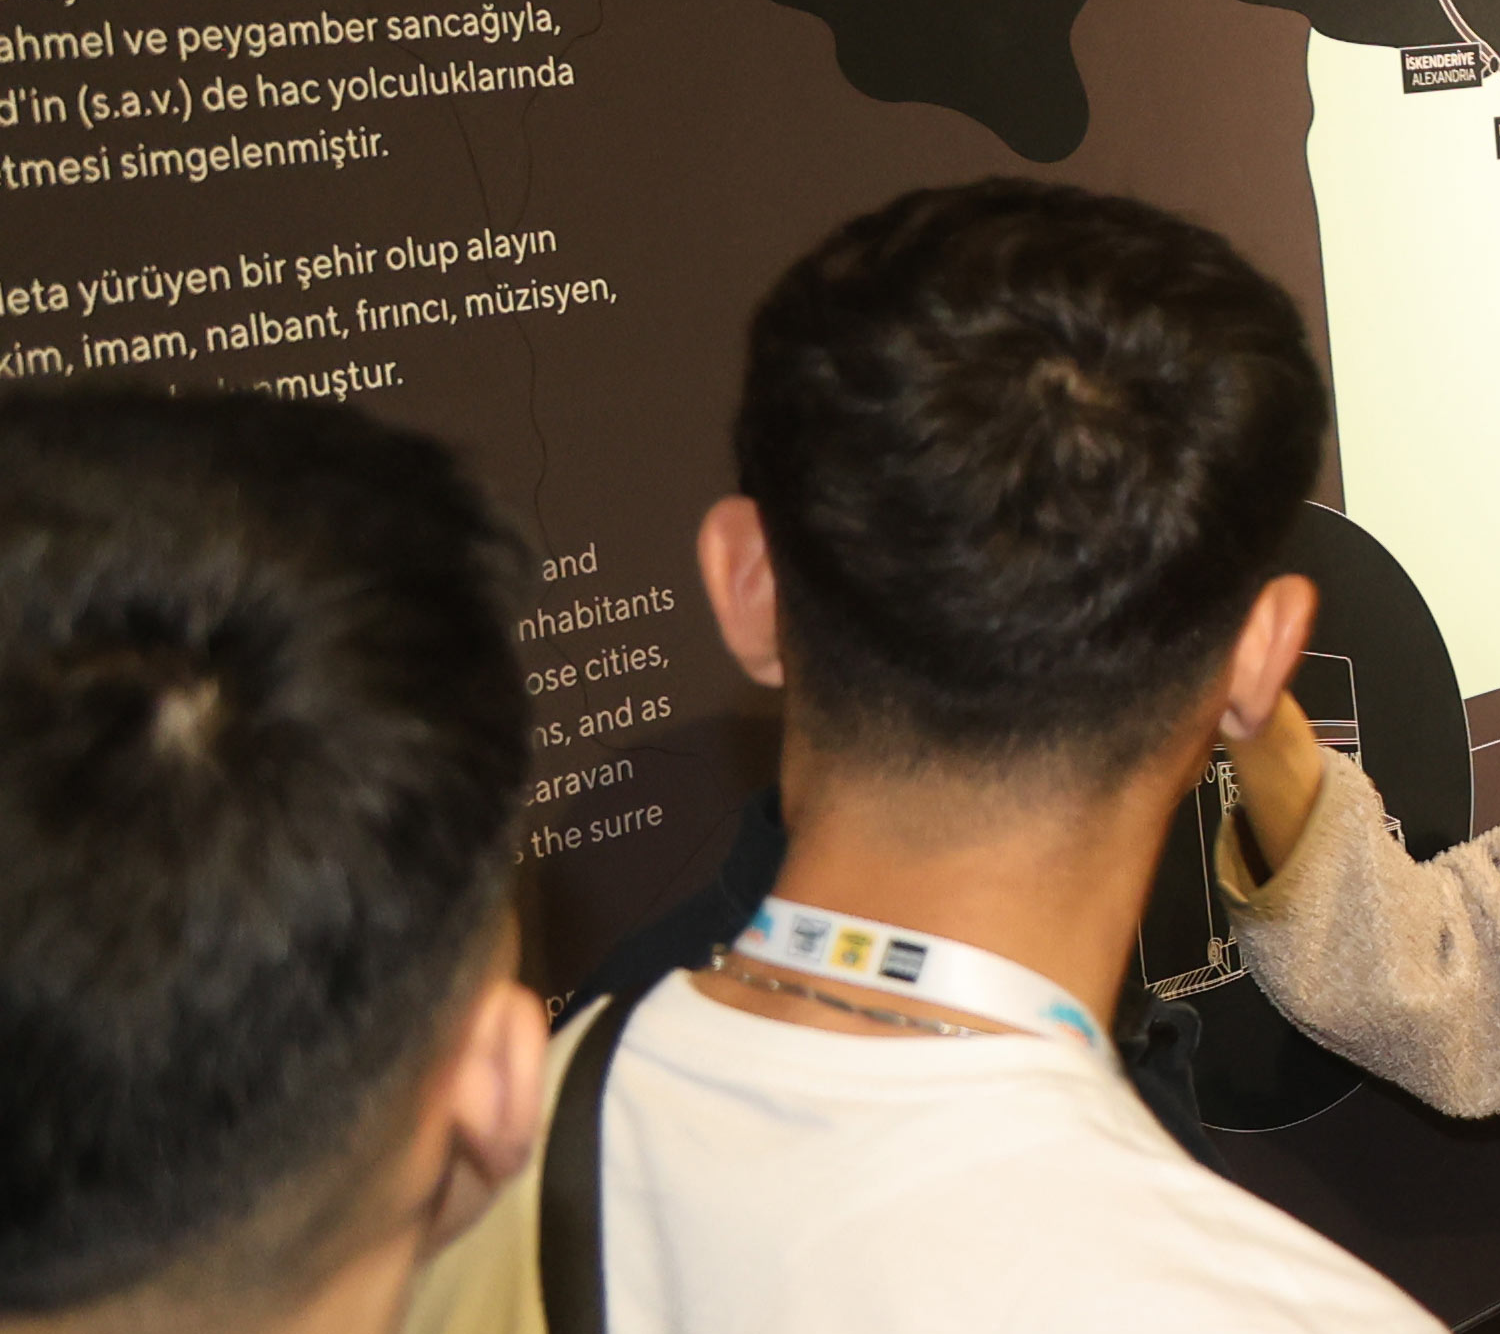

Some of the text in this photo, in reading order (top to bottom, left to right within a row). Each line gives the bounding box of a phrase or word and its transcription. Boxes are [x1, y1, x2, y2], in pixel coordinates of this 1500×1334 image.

[123, 29, 167, 55] ve
[178, 11, 378, 61] peygamber
[387, 2, 560, 43] sancağıyla,
[1405, 49, 1476, 71] İSKENDERİYE
[1412, 67, 1477, 87] ALEXANDRIA
[79, 78, 191, 129] (s.a.v.)
[202, 77, 247, 111] de
[257, 74, 320, 107] hac
[328, 56, 574, 111] yolculuklarında
[0, 126, 388, 189] tmesi simgelenmiştir.
[78, 266, 230, 316] yürüyen
[240, 253, 286, 287] bir
[296, 243, 377, 289] şehir
[386, 237, 458, 273] olup
[467, 228, 556, 264] alayın
[83, 332, 197, 367] imam,
[207, 306, 348, 351] nalbant,
[356, 299, 457, 331] fırıncı,
[466, 279, 616, 317] müzisyen,
[543, 543, 597, 581] and
[519, 587, 674, 641] nhabitants
[585, 645, 668, 680] cities,
[579, 697, 633, 737] and
[642, 696, 671, 721] as
[526, 760, 633, 806] aravan
[531, 826, 581, 858] the
[590, 805, 662, 842] surre
